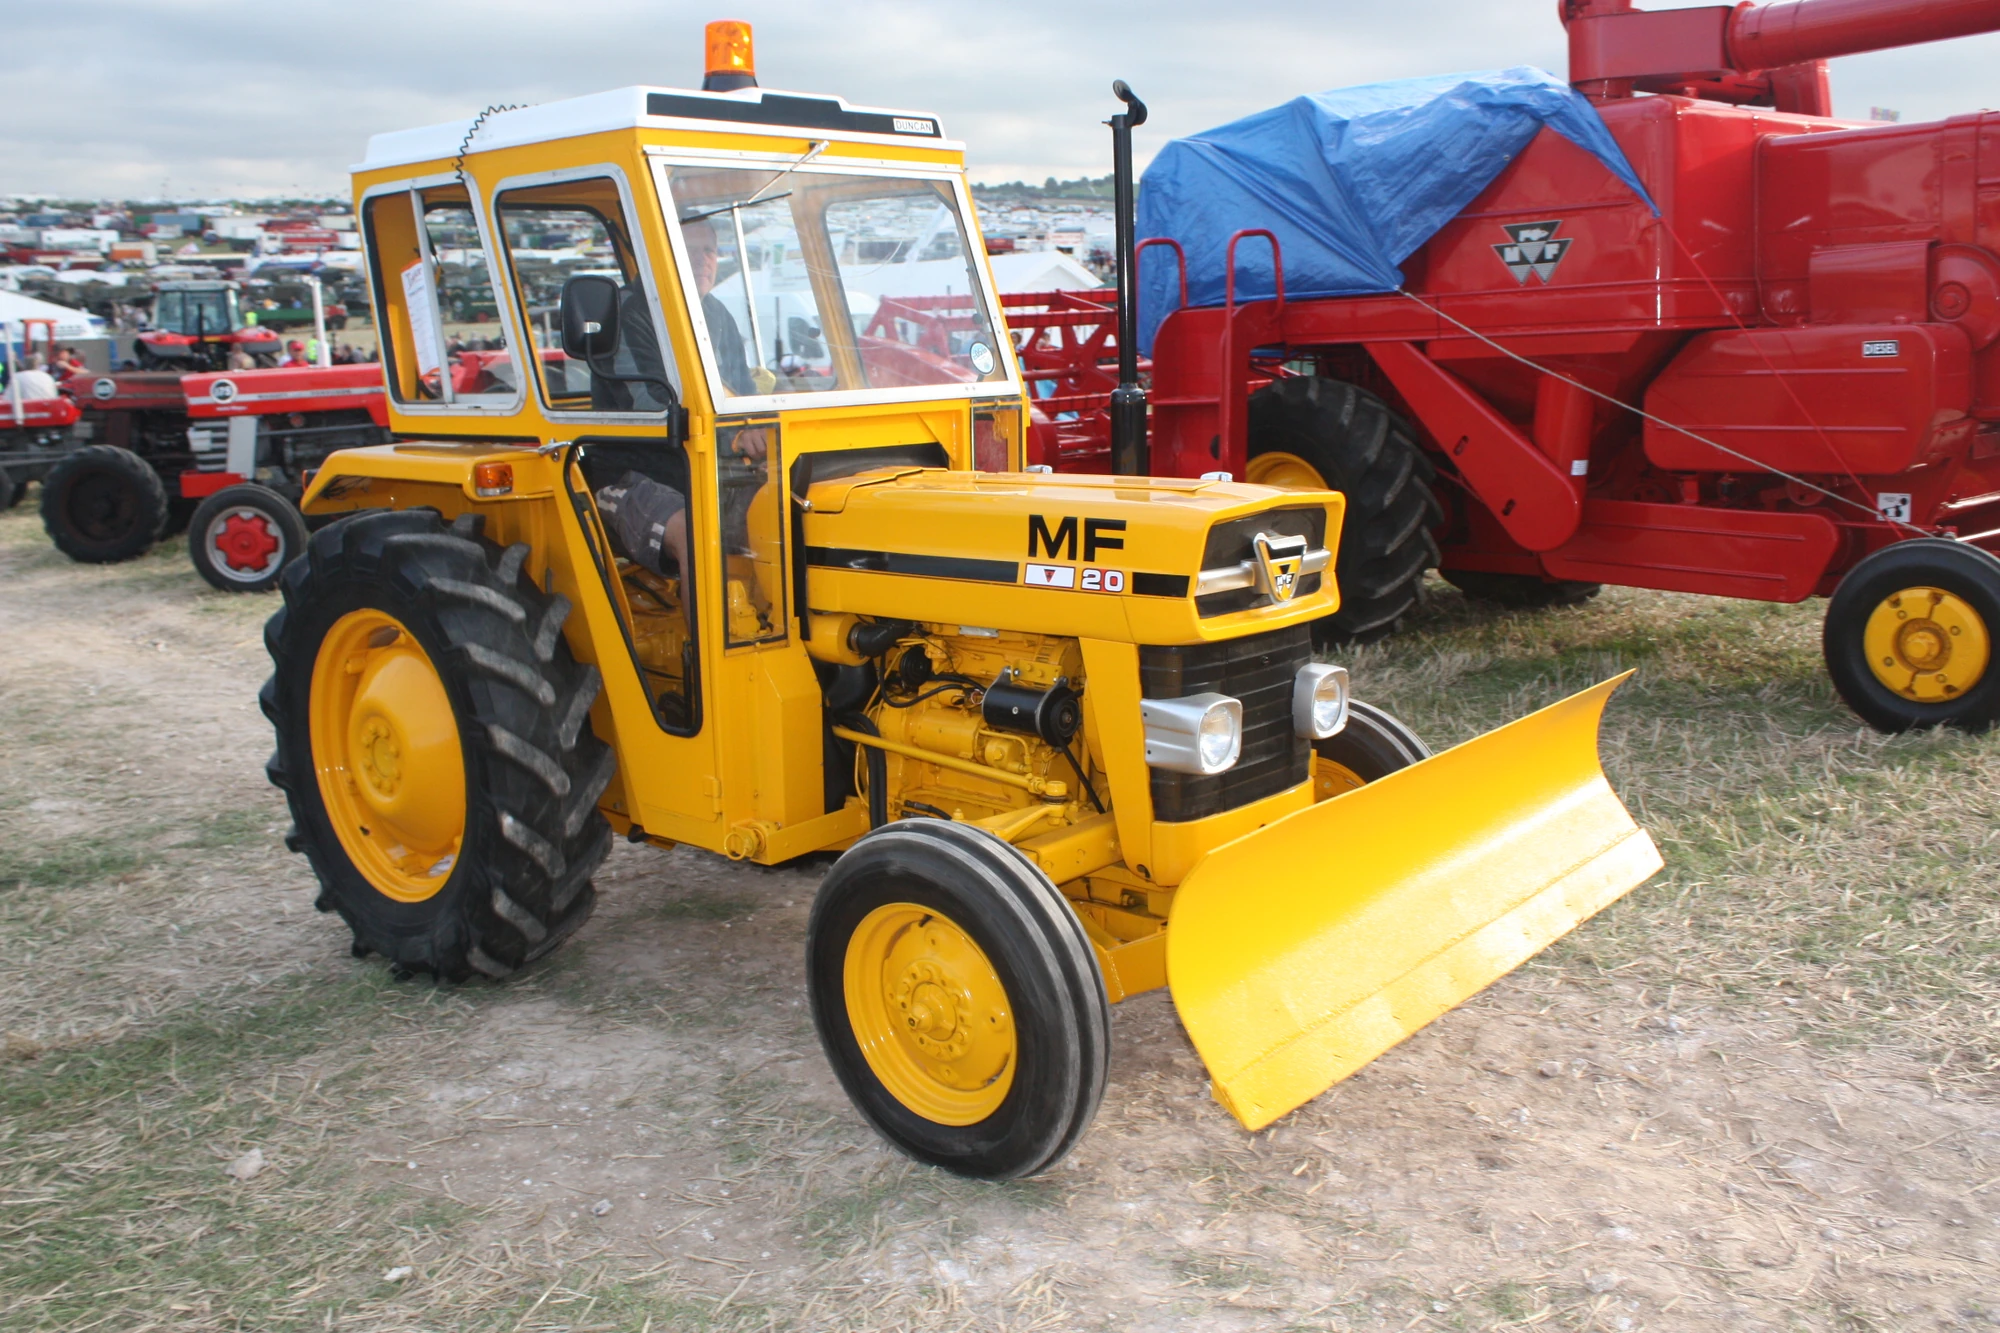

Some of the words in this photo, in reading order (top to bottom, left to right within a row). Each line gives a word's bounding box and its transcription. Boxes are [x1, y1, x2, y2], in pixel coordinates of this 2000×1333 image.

[895, 120, 932, 131] DUNCAN
[1863, 343, 1897, 355] DIESEL
[1028, 514, 1127, 562] MF
[1081, 568, 1124, 593] 20
